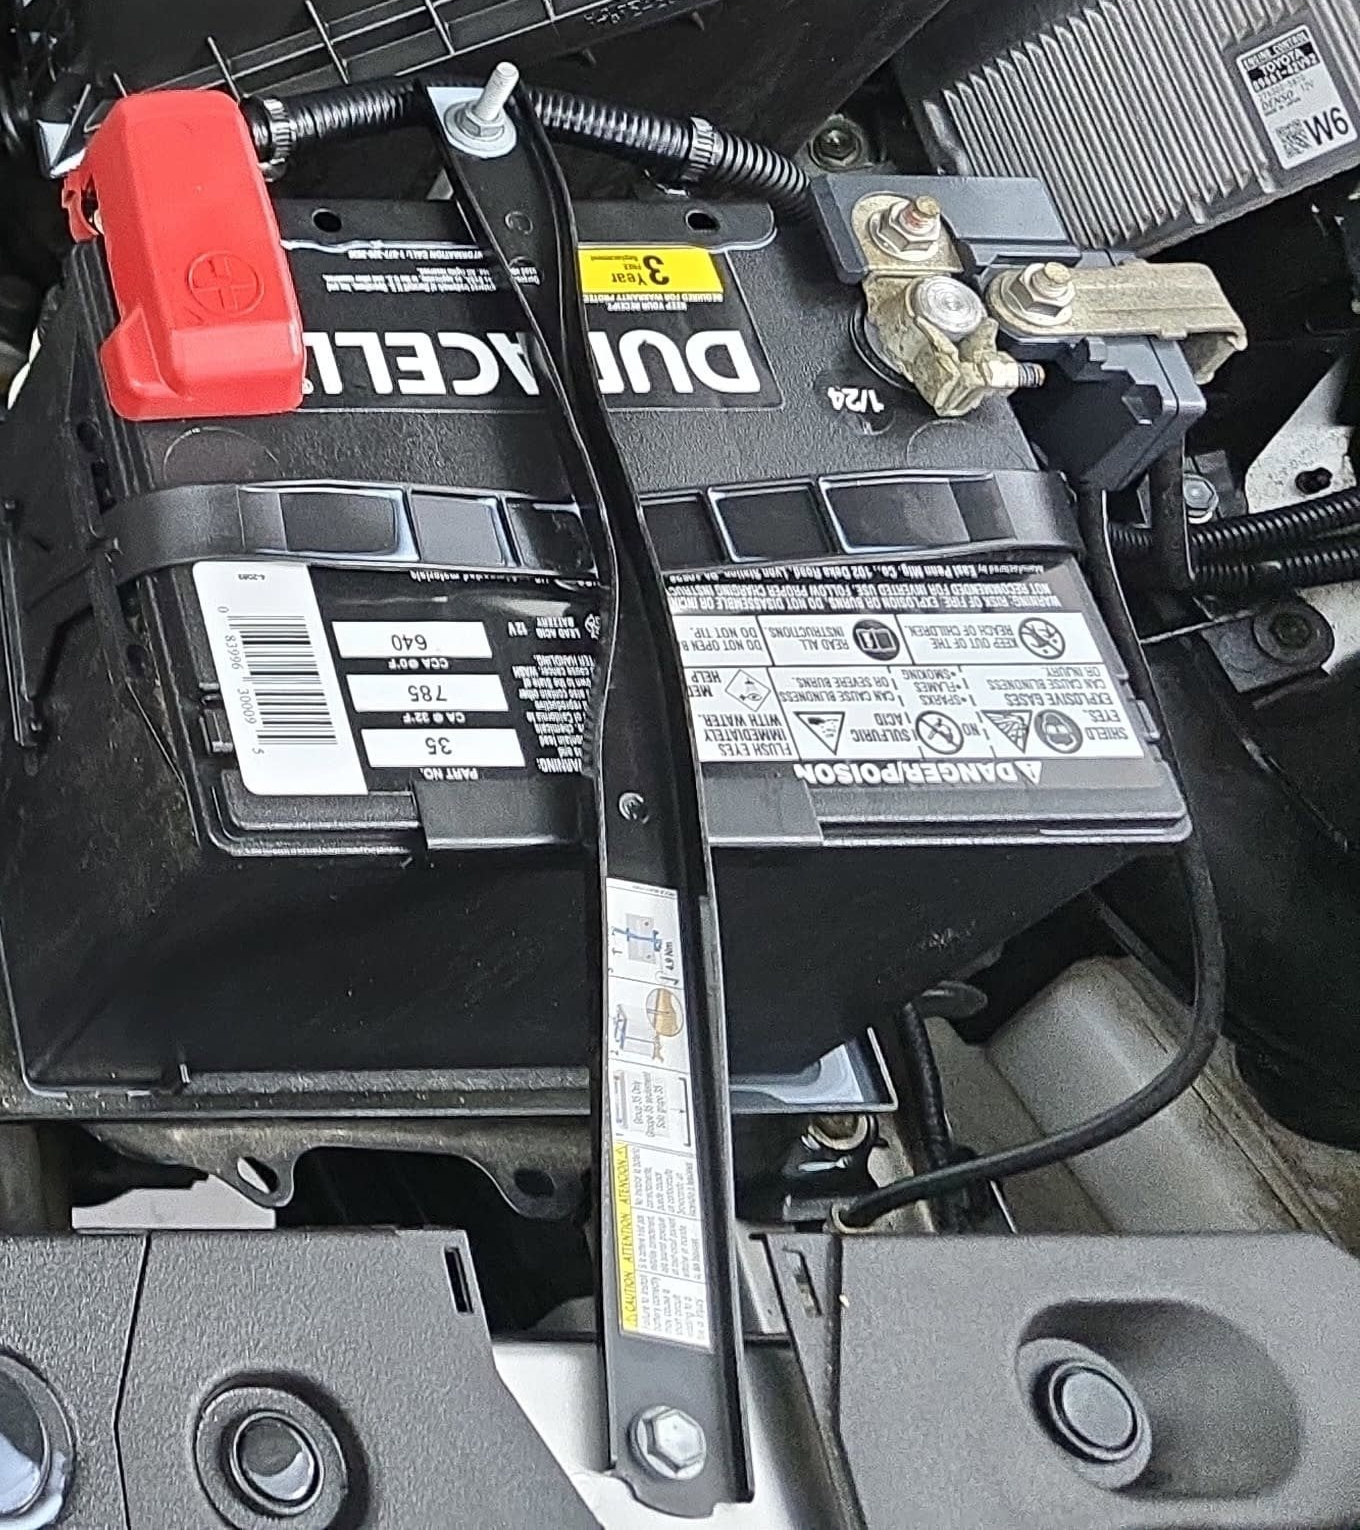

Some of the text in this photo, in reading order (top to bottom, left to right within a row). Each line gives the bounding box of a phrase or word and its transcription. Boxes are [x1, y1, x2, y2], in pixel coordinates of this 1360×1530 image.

[1258, 48, 1306, 75] TOYOTA
[1303, 107, 1349, 146] W6
[642, 255, 670, 286] 3
[610, 272, 648, 286] Year
[641, 302, 664, 311] YOUR
[827, 386, 885, 413] 1/24
[924, 565, 953, 578] Penn
[953, 564, 978, 578] East
[714, 597, 785, 610] DISASSEMBLE
[689, 626, 758, 638] DO NOT TIP.
[764, 626, 845, 638] INSTRUCTIONS.
[904, 624, 1014, 636] REACH OF CHILDREN.
[392, 634, 428, 651] 640
[692, 640, 720, 651] OPEN
[722, 640, 744, 651] NOT
[746, 640, 762, 651] DO
[798, 638, 849, 650] READ ALL
[929, 637, 1018, 649] KEEP OUT OF THE
[217, 606, 230, 614] 0
[224, 634, 244, 670] 83996
[236, 688, 258, 724] 30009
[420, 658, 449, 670] CCA
[690, 670, 721, 683] HELP
[900, 669, 950, 680] SMOKING
[791, 676, 889, 688] OR SEVERE BURNS.
[912, 681, 957, 692] FLAMES
[986, 679, 1106, 690] CAN CAUSE BLINDNESS
[408, 686, 448, 702] 785
[778, 690, 895, 703] CAN CAUSE BLINDNESS
[919, 694, 960, 705] SPARKS
[1004, 692, 1113, 706] EXPLOSIVE GASES
[446, 712, 466, 724] CA
[698, 714, 782, 727] WITH WATER.
[873, 712, 903, 726] ACID
[1082, 708, 1121, 722] EYES.
[703, 728, 787, 742] IMMEDIATELY
[850, 728, 910, 742] SULFURIC
[961, 723, 981, 736] NO
[1084, 726, 1128, 740] SHIELD
[425, 737, 452, 755] 35
[718, 742, 792, 756] FLUSH EYES
[419, 768, 478, 780] PART NO.
[792, 760, 1018, 784] DANGER/POISON
